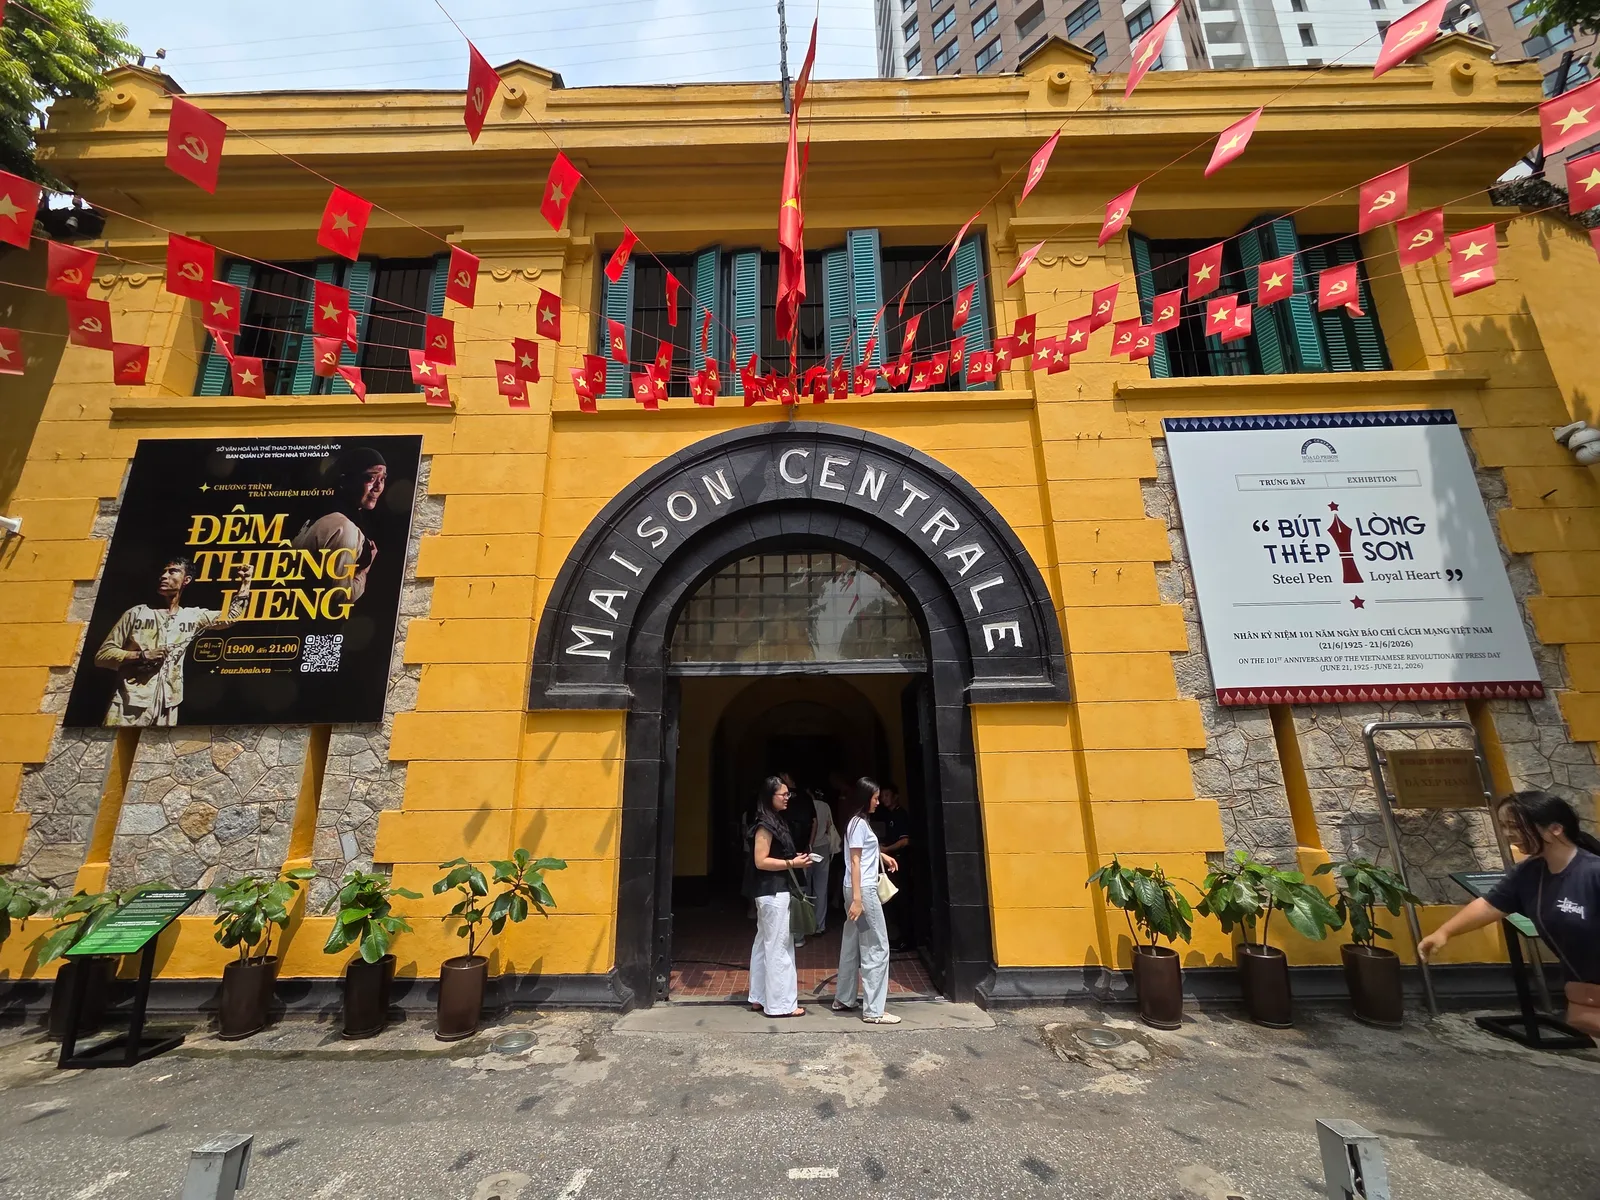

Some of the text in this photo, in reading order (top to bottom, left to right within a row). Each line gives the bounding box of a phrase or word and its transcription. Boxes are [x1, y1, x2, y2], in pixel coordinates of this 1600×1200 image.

[1290, 478, 1306, 486] BÀY
[1346, 476, 1398, 484] EXHIBITION
[268, 490, 300, 498] NGHIỆM
[320, 488, 335, 496] TỐI
[185, 504, 290, 546] ĐÊM
[1278, 512, 1426, 538] BÚT LÒNG
[565, 448, 1024, 660] MAISON CENTRALE
[1264, 540, 1414, 564] THÉP SON
[193, 539, 360, 582] THIÊNG
[1272, 570, 1442, 584] Steel Pen Loyal Heart
[216, 578, 355, 622] LIÊNG
[1233, 630, 1259, 640] NHÂN
[1260, 630, 1272, 639] KỶ
[1274, 630, 1298, 640] NIỆM
[1315, 630, 1336, 638] NĂM
[1336, 628, 1360, 638] NGÀY
[1361, 628, 1378, 637] BÁO
[1380, 627, 1396, 636] CHÍ
[1397, 626, 1422, 636] CÁCH
[1423, 627, 1450, 636] MẠNG
[1450, 626, 1471, 636] VIỆT
[1472, 626, 1494, 634] NAM
[226, 644, 254, 654] 19:00
[268, 644, 298, 653] 21:00
[1318, 641, 1364, 650] (21/6/1925
[1368, 640, 1414, 649] 21/6/2026)
[1406, 652, 1464, 660] REVOLUTIONARY
[220, 666, 272, 674] tour.hoalo.vn
